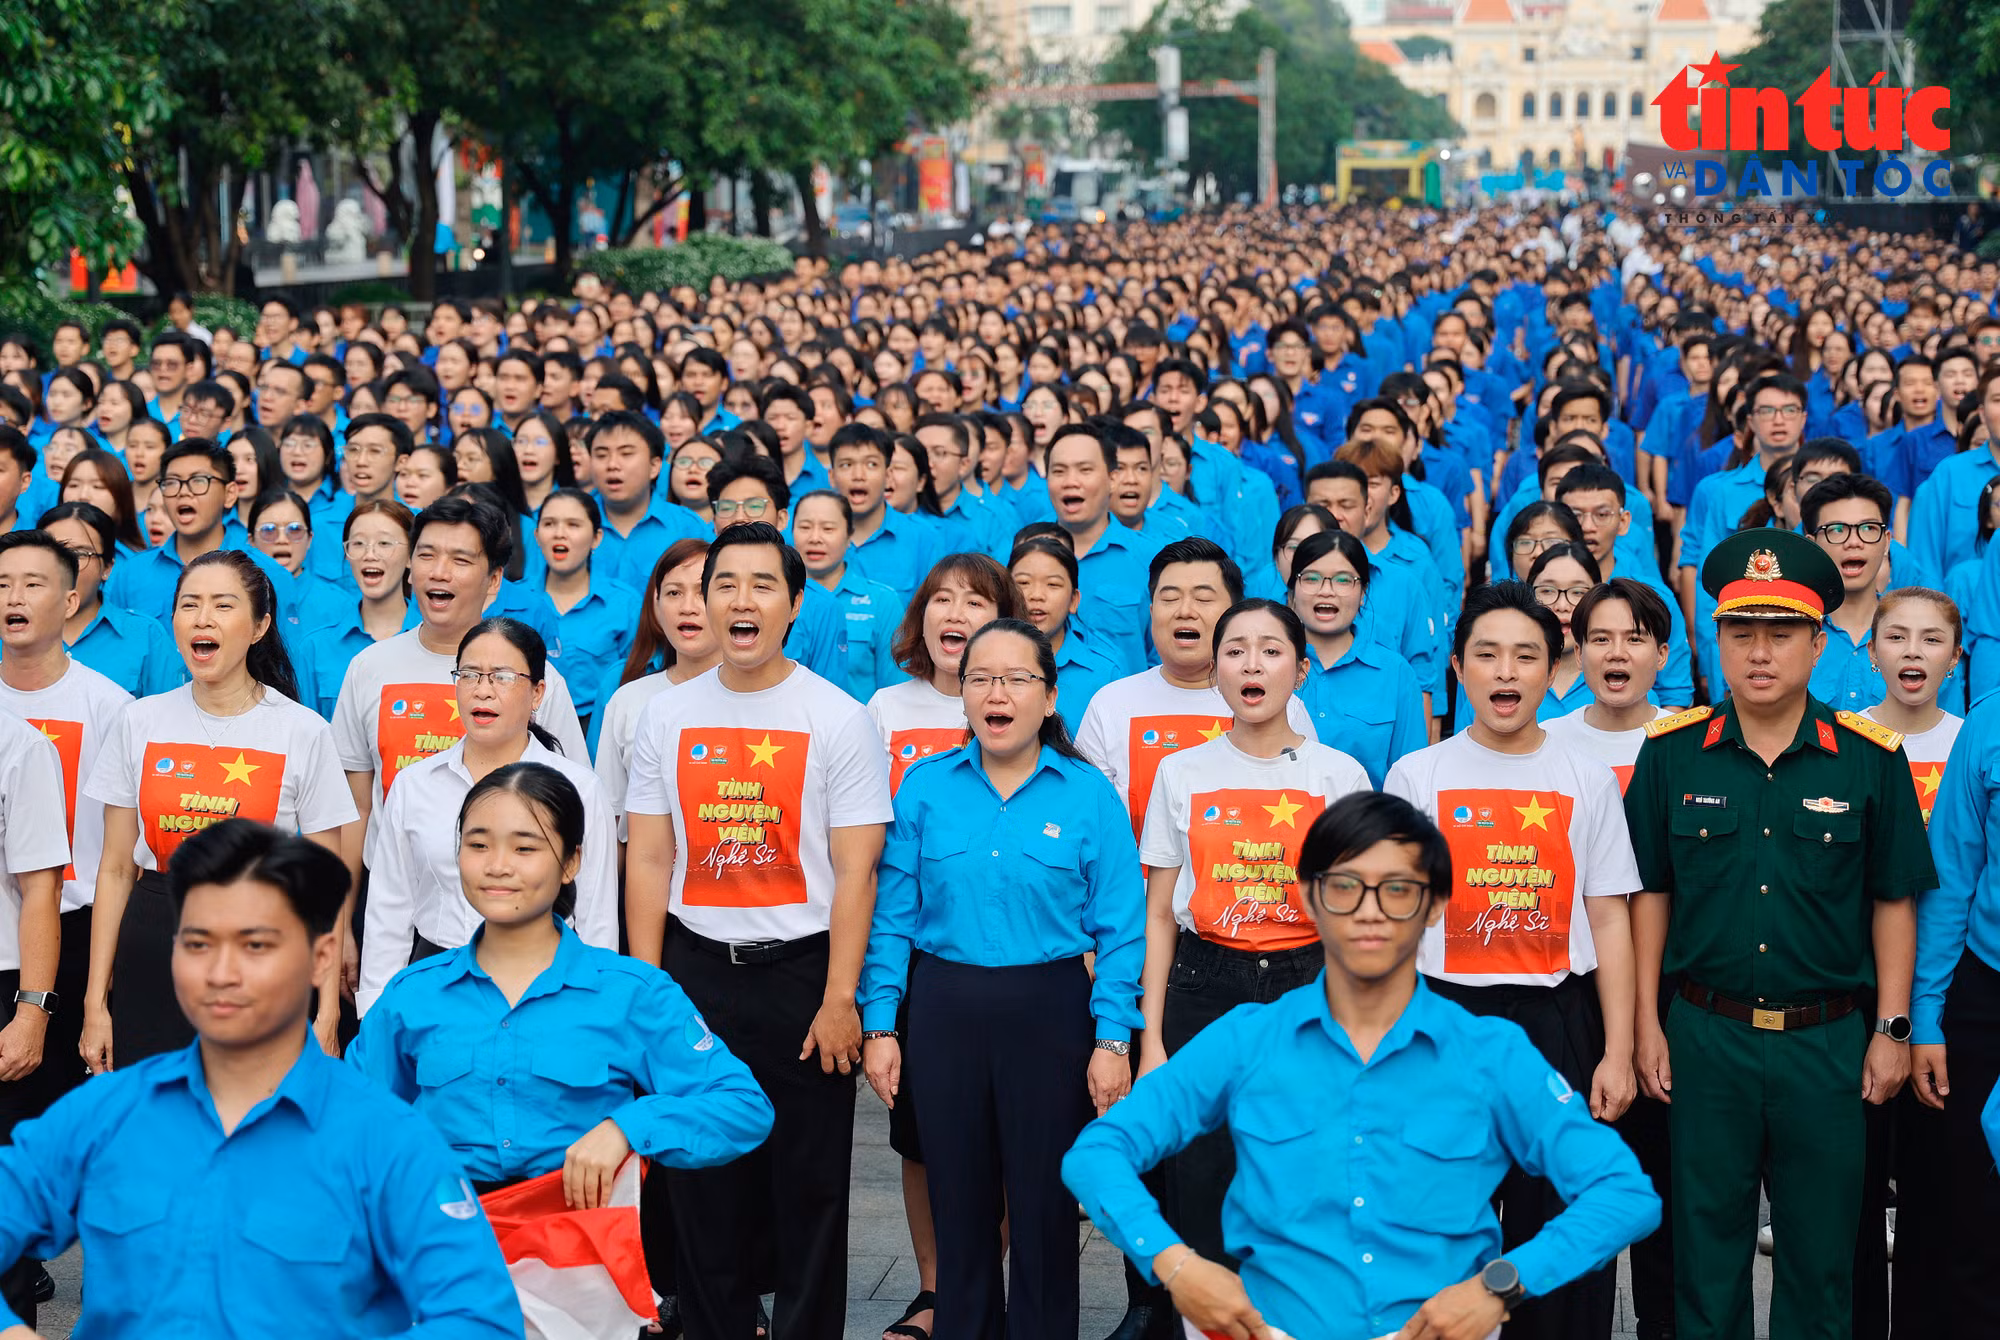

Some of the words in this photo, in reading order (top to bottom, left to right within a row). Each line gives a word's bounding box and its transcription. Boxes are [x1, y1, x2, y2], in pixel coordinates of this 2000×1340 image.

[717, 777, 764, 800] TÌNH
[179, 790, 240, 816] TÌNH
[698, 801, 782, 825] NGUYỆN
[718, 824, 766, 845] VIÊN
[700, 837, 749, 880] Nghệ
[753, 844, 777, 865] Sĩ
[1232, 839, 1285, 861] TÌNH
[1486, 841, 1538, 863] TÌNH
[1211, 861, 1298, 887] NGUYỆN
[1466, 865, 1556, 891] NGUYỆN
[1234, 882, 1287, 904] VIÊN
[1488, 888, 1540, 910] VIÊN
[1213, 896, 1267, 937] Nghệ
[1273, 904, 1299, 924] Sĩ
[1466, 901, 1519, 946] Nghệ
[1524, 910, 1550, 932] Sĩ
